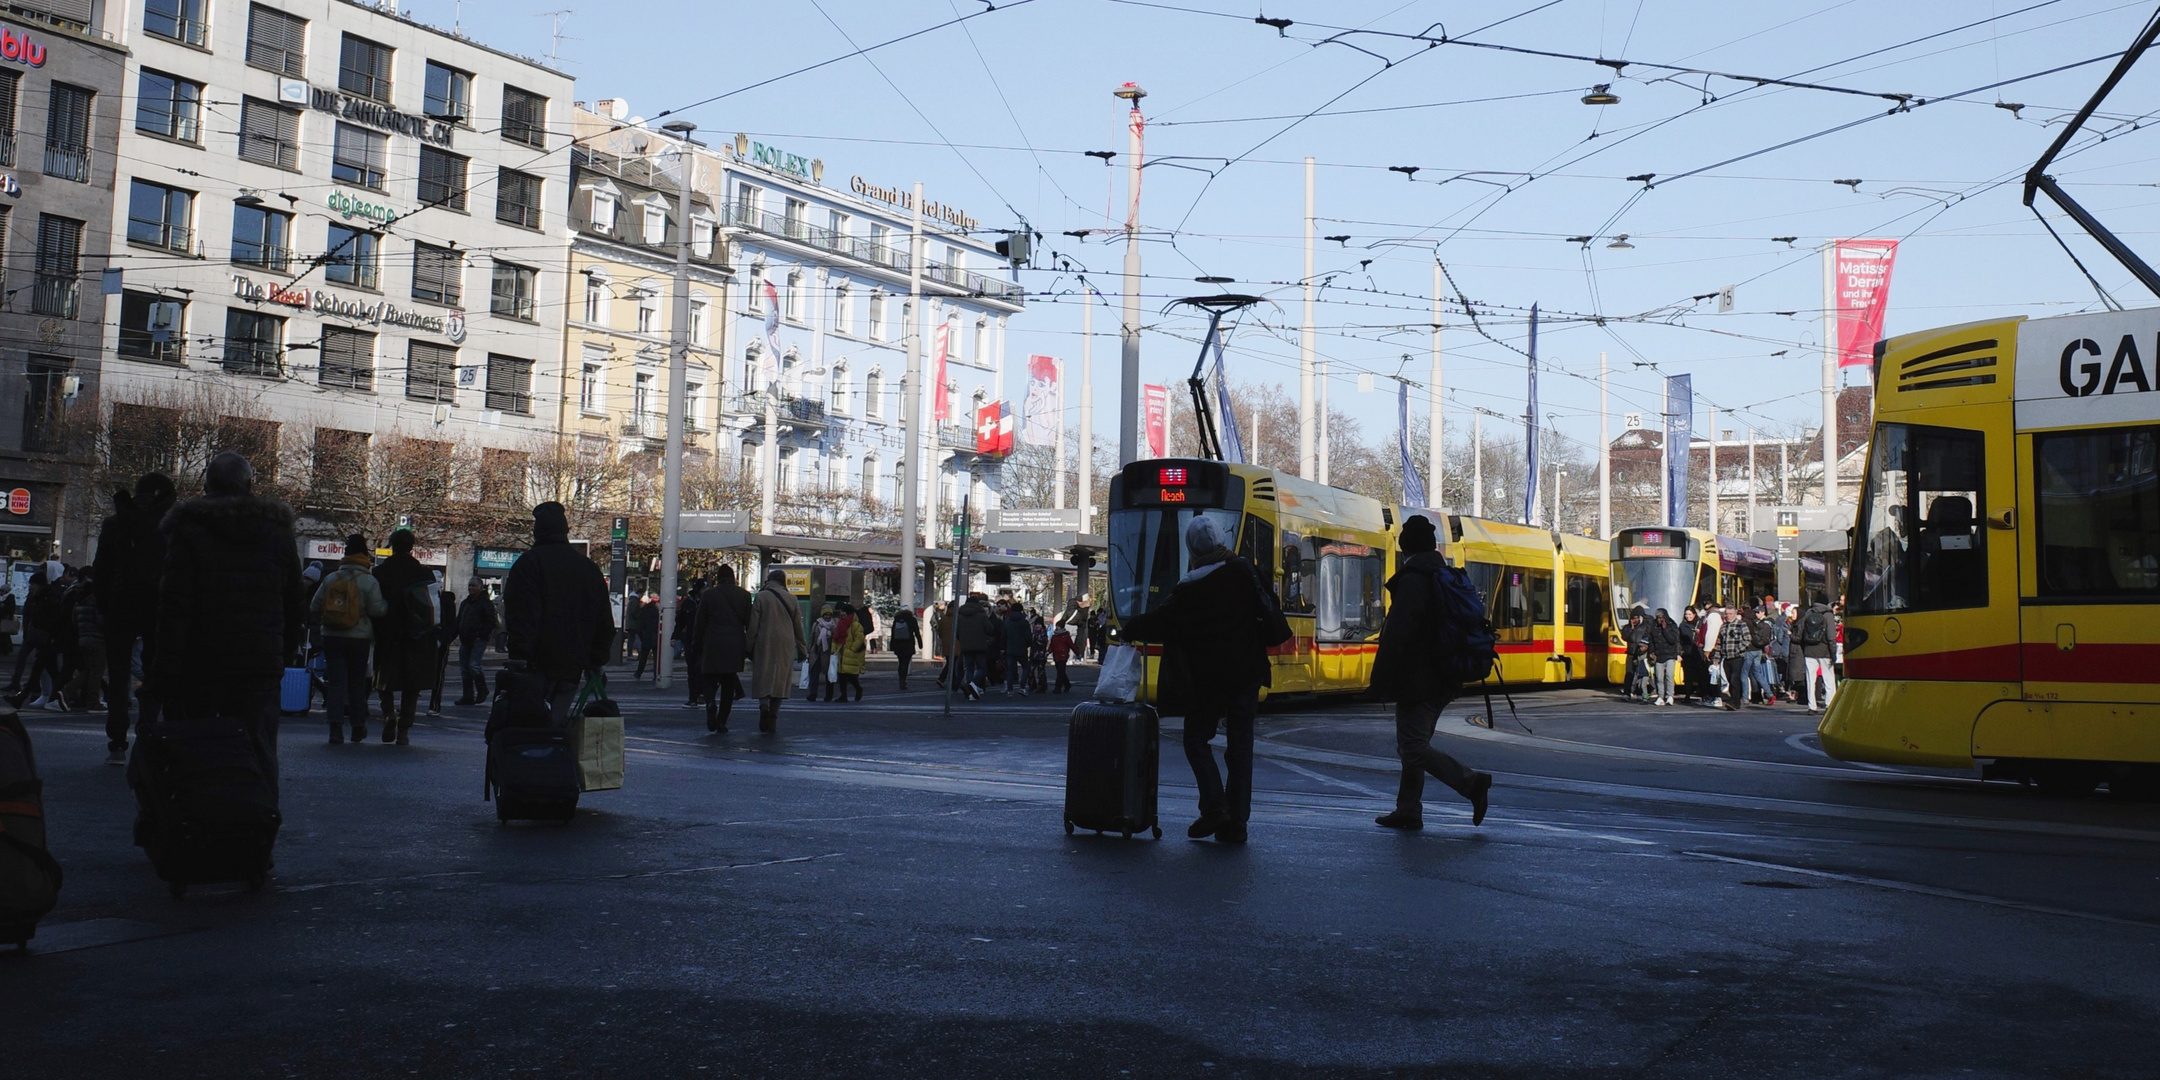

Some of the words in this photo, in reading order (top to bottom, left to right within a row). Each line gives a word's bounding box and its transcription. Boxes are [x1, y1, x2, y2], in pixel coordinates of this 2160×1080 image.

[1, 27, 46, 66] blu
[312, 87, 341, 114] DIE
[753, 141, 809, 177] ROLEX
[327, 189, 395, 225] digicomp
[851, 174, 899, 205] Grand
[901, 191, 941, 219] Htel
[943, 204, 979, 231] Euler
[1722, 290, 1732, 307] 15
[1843, 290, 1860, 298] und
[1861, 290, 1873, 298] ihr
[232, 275, 263, 298] The
[267, 281, 311, 306] Basel
[313, 290, 365, 318] School
[364, 301, 384, 323] of
[384, 303, 445, 331] Business
[2060, 331, 2160, 397] GA
[462, 369, 475, 382] 25
[1626, 416, 1640, 427] 25
[1166, 469, 1182, 481] 11
[400, 516, 408, 526] D
[616, 519, 621, 529] E
[957, 515, 964, 526] F
[1782, 514, 1792, 526] H
[1647, 534, 1659, 543] 11
[328, 543, 346, 554] libri
[2047, 692, 2059, 700] 172
